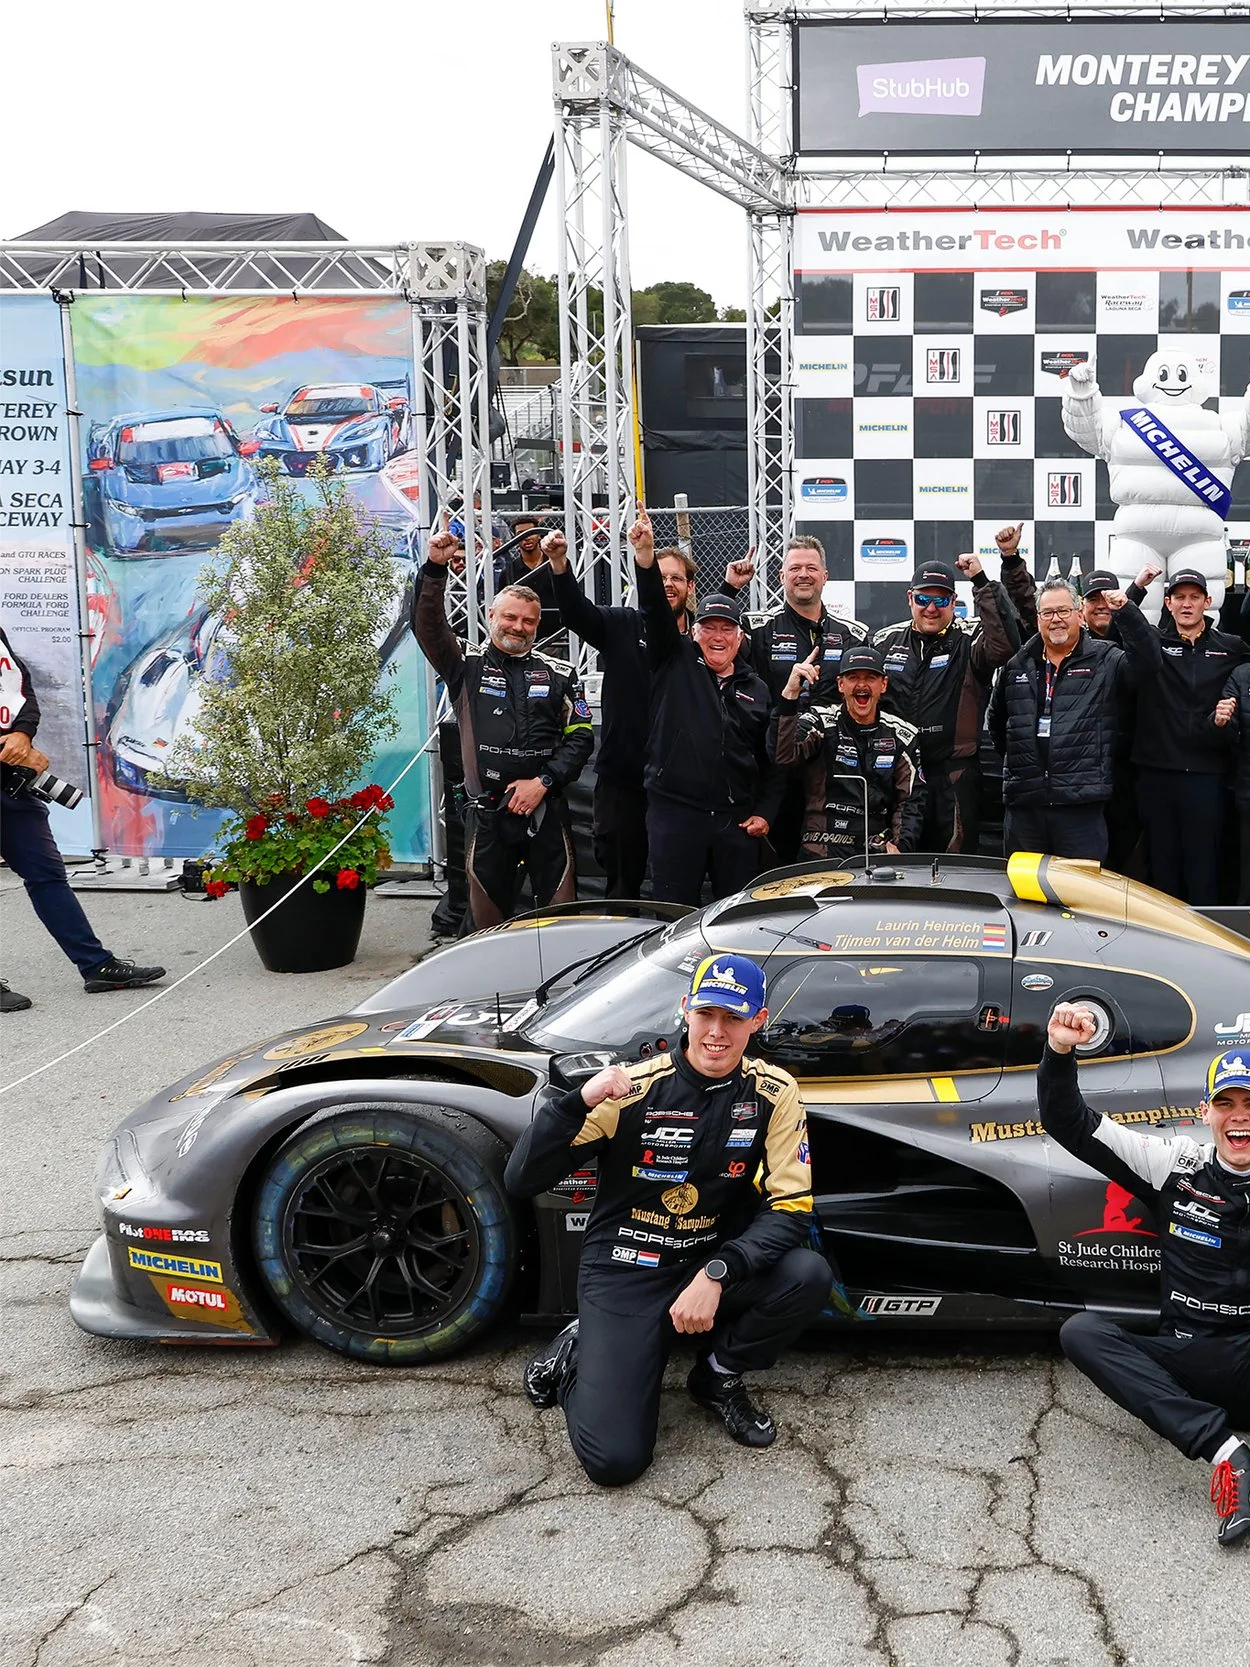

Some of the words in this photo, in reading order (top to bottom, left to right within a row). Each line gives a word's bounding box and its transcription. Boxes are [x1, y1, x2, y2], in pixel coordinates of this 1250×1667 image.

[1035, 54, 1250, 86] MONTEREY
[872, 77, 970, 98] StubHub
[1130, 411, 1224, 503] MICHELIN
[33, 459, 62, 475] 3-4
[9, 492, 63, 508] SECA
[13, 567, 41, 575] SPARK
[43, 567, 67, 575] PLUG
[18, 576, 68, 584] CHALLENGE
[4, 593, 27, 601] FORD
[28, 593, 69, 601] DEALERS
[1, 601, 43, 609] FORMULA
[45, 601, 70, 609] FORD
[20, 609, 70, 618] CHALLENGE
[51, 636, 72, 644] $2.00
[479, 744, 553, 757] PORSCHE
[875, 920, 920, 931] Laurin
[923, 920, 981, 933] Heinrich
[835, 935, 881, 950] Tijmen
[885, 937, 911, 947] van
[915, 935, 938, 947] der
[942, 935, 980, 948] Helm
[700, 980, 748, 995] MICHELIN
[760, 1082, 780, 1096] OMP
[969, 1120, 1047, 1145] Musta
[1100, 1104, 1203, 1126] ampling
[649, 1171, 683, 1180] MICHELIN
[631, 1208, 670, 1229] Mustang
[618, 1227, 718, 1248] PORSCHE
[1183, 1230, 1217, 1244] MICHELIN
[612, 1248, 637, 1261] OMP
[1058, 1242, 1075, 1254] St.
[1076, 1242, 1107, 1257] Jude
[1110, 1243, 1162, 1258] Childre
[131, 1252, 219, 1278] MICHELIN
[1059, 1256, 1118, 1269] Research
[1121, 1259, 1162, 1273] Hospi
[170, 1287, 225, 1308] MOTUL
[884, 1300, 935, 1312] GTP
